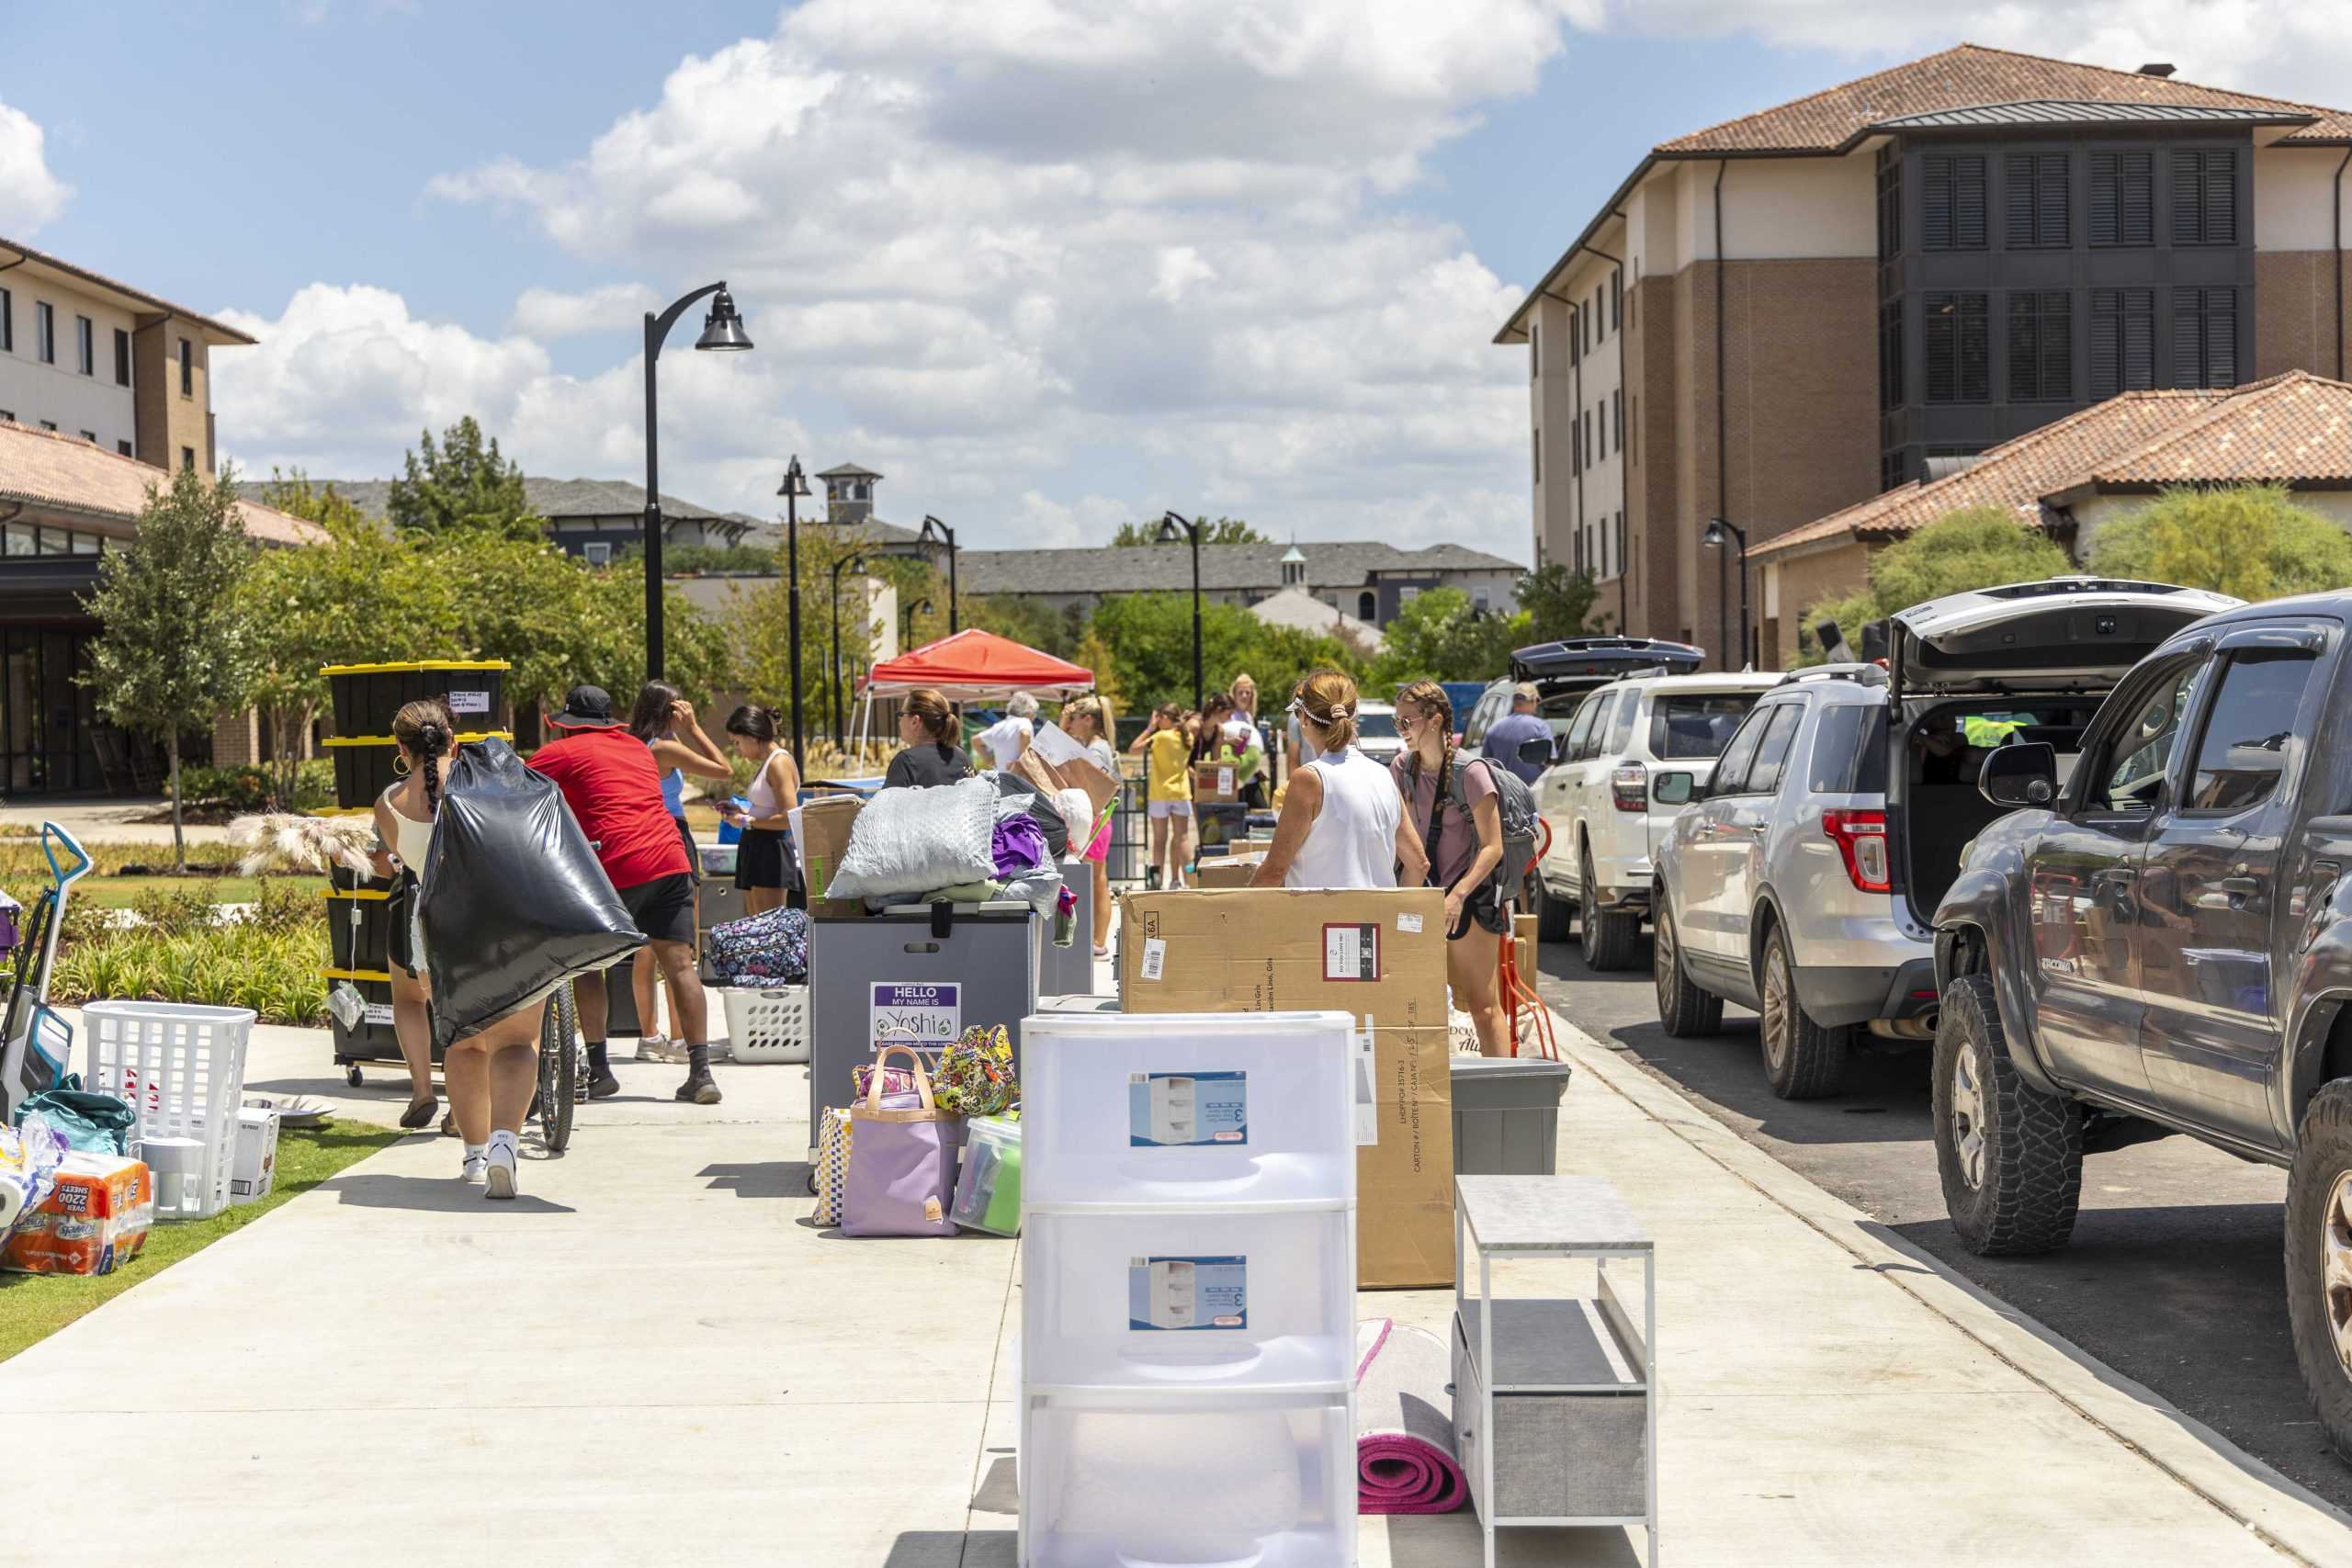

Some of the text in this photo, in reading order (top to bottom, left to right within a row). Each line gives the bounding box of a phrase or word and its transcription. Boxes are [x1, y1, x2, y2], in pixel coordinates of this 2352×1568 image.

[2041, 957, 2074, 972] TACOMA
[895, 987, 937, 998] HELLO
[887, 1010, 936, 1036] Yoshi
[1397, 1060, 1406, 1087] 35716-3
[1234, 1109, 1243, 1122] 3
[1413, 1141, 1421, 1173] CARTON
[61, 1185, 88, 1194] SHEETS
[58, 1193, 87, 1204] 2200
[67, 1204, 85, 1213] OVER
[1234, 1293, 1243, 1306] 3
